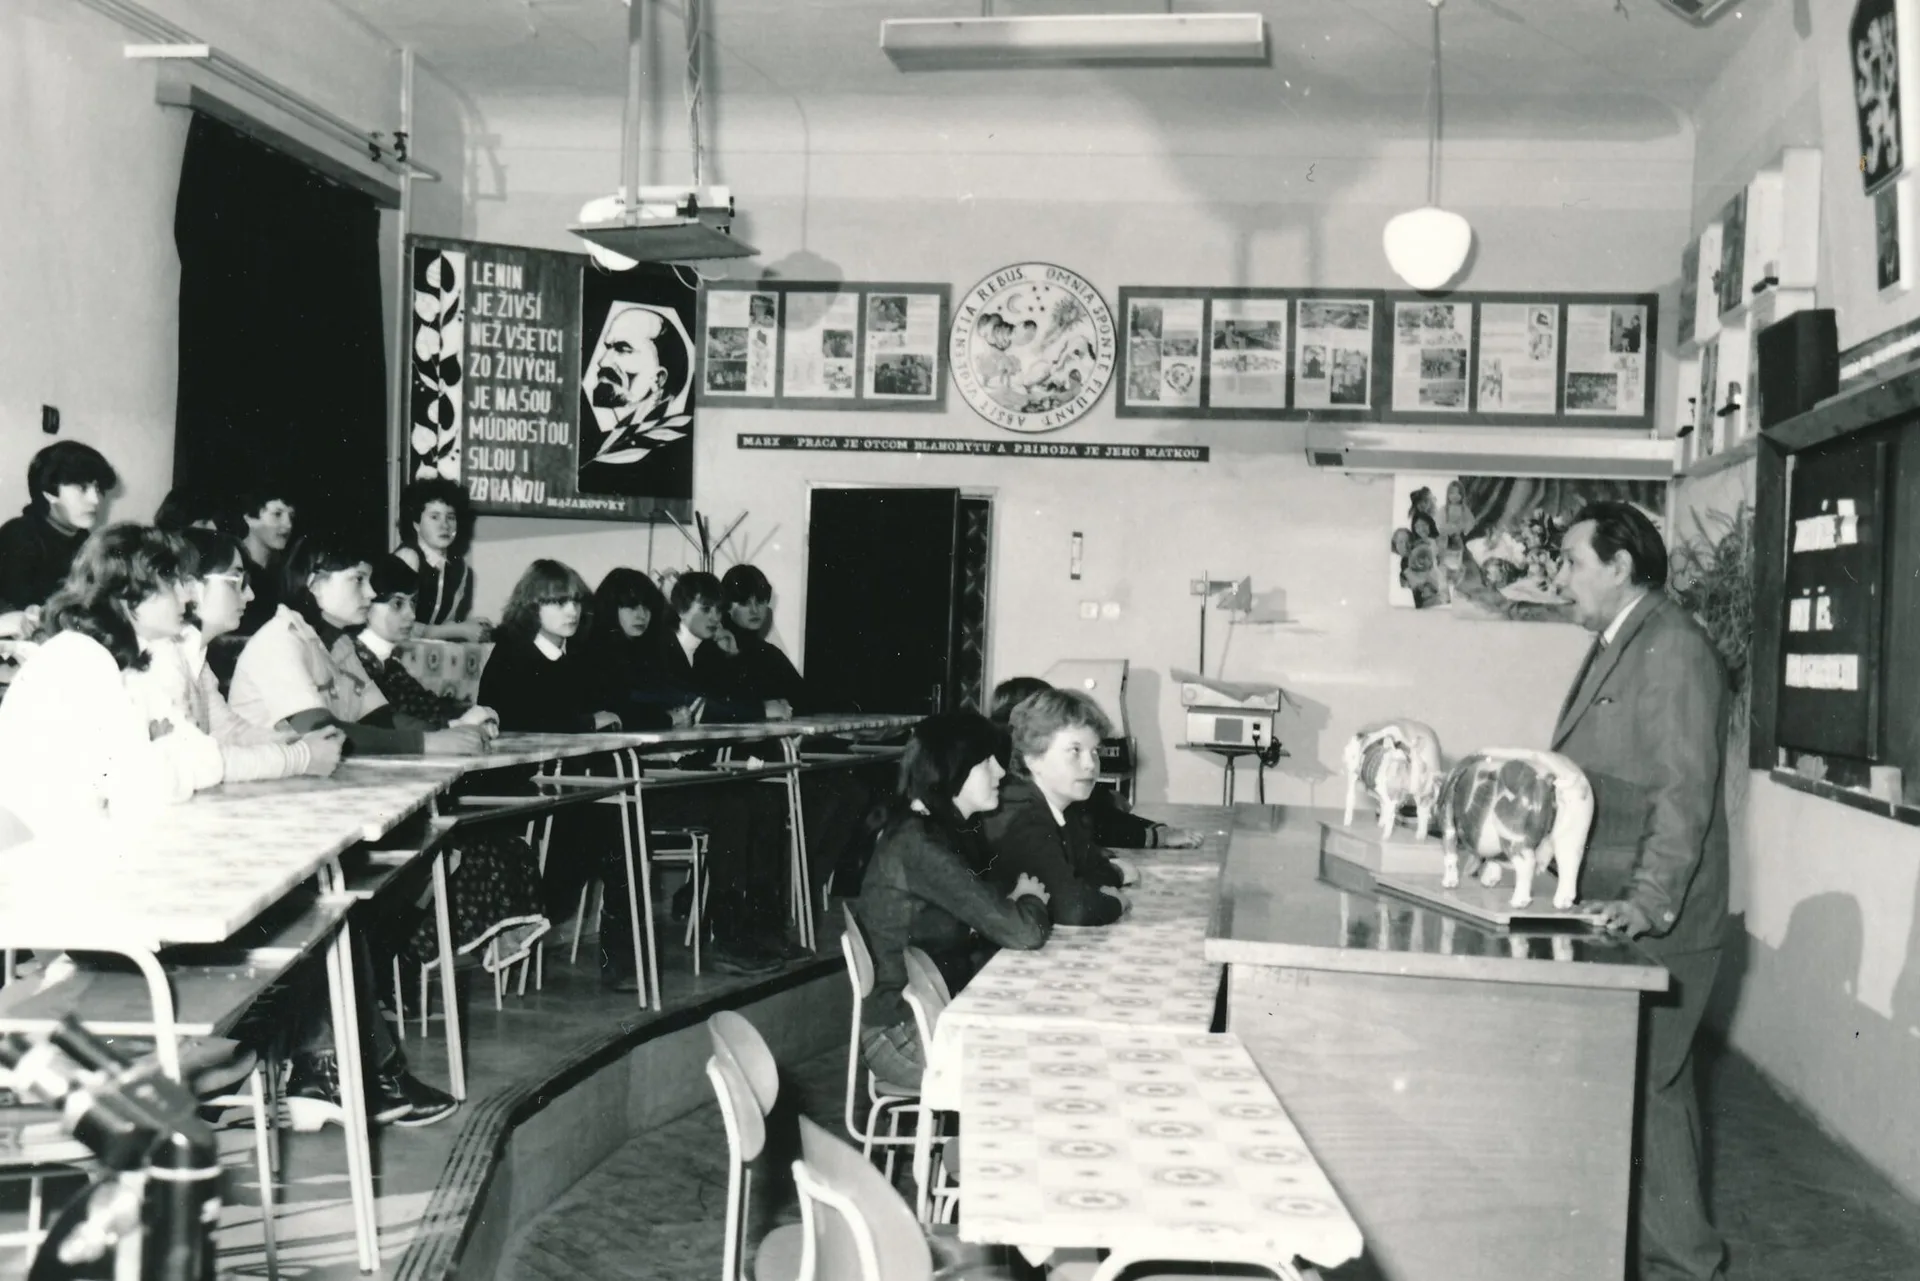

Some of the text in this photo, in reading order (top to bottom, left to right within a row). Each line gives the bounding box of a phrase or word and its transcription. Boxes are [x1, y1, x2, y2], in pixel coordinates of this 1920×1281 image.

[472, 260, 523, 290] LENIN
[977, 267, 1025, 302] REBUS
[1046, 267, 1096, 304] OMNIA
[471, 290, 542, 320] JE ŽIVŠÍ
[470, 320, 563, 353] NEŽ VŠETCI
[1091, 305, 1113, 373] SPONTE
[469, 351, 564, 384] ZO ŽIVÝCH.
[469, 385, 551, 414] JE NAŠOU
[1041, 379, 1104, 427] FLUANT
[468, 446, 529, 473] SILOU I
[742, 436, 780, 447] MARX
[863, 439, 908, 450] OTCOM
[997, 443, 1006, 453] A
[1084, 445, 1100, 456] JE
[1105, 446, 1140, 457] JEHO
[1145, 447, 1201, 459] MATKOU
[468, 474, 546, 504] ZBRAŇOU
